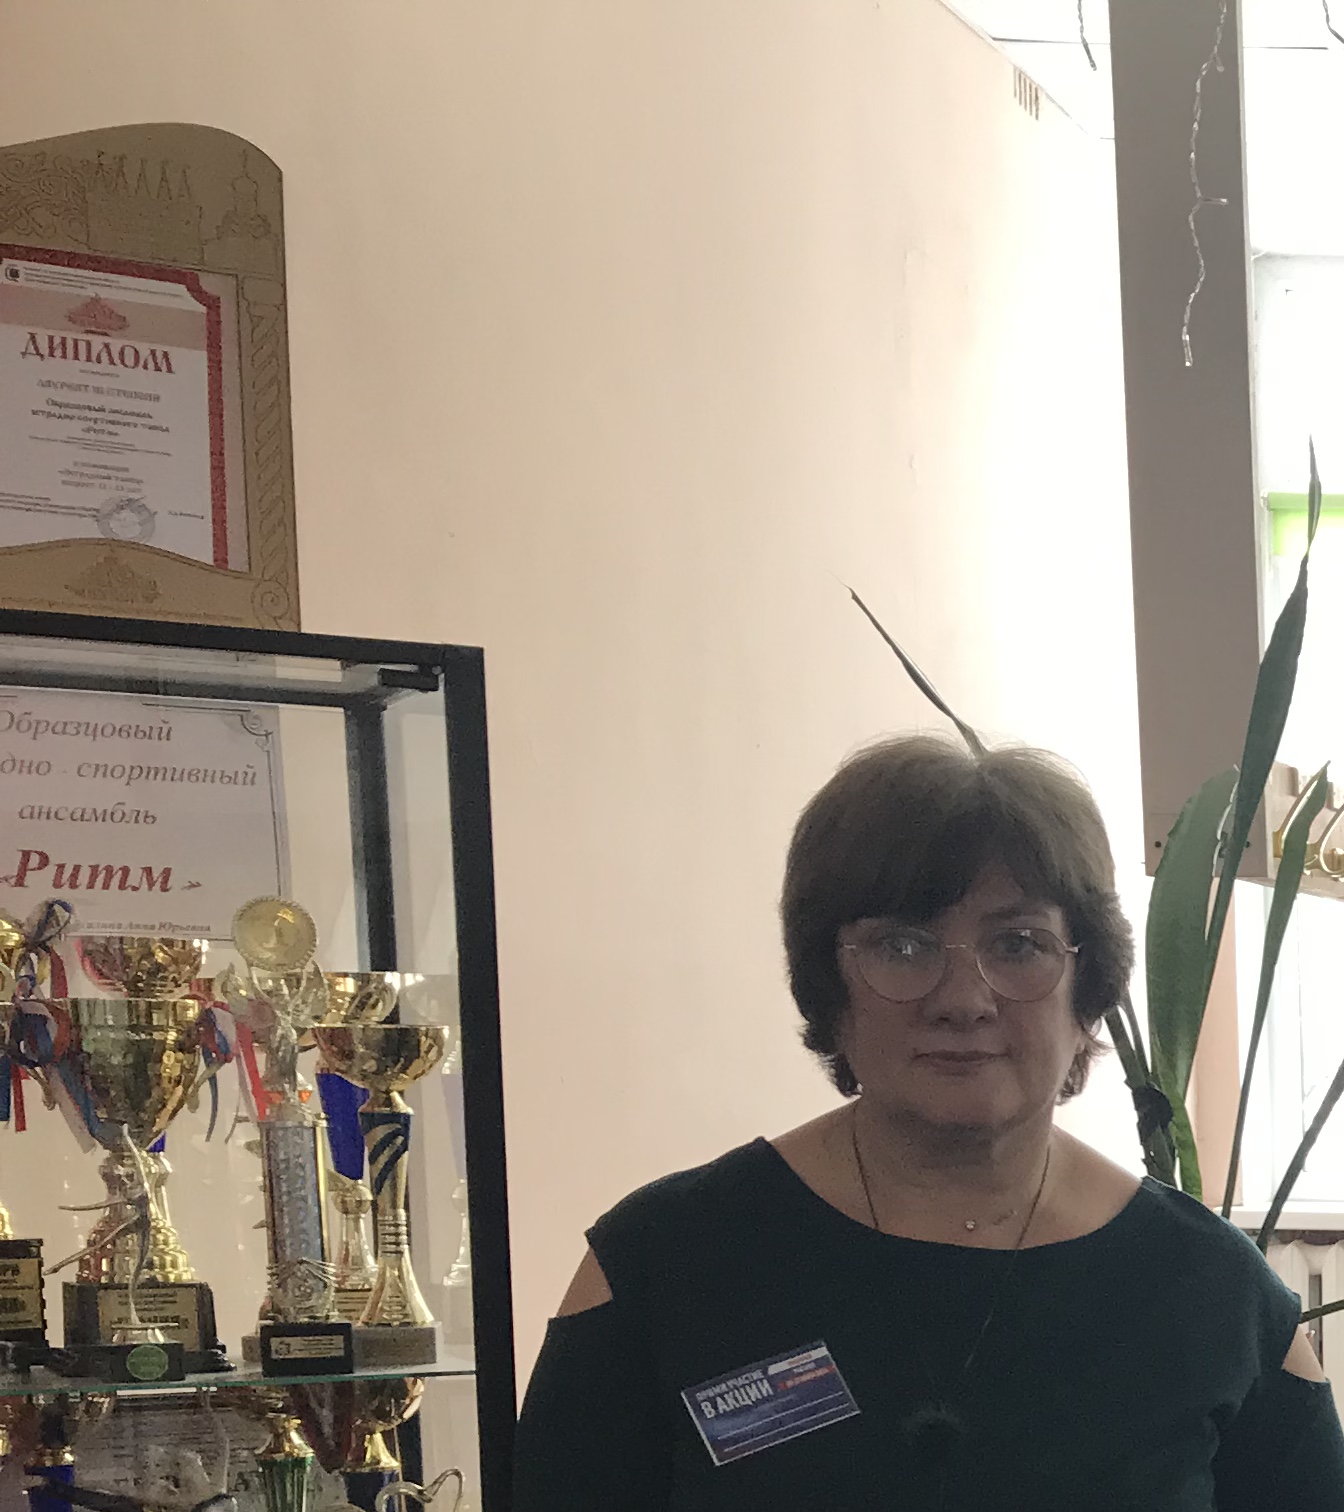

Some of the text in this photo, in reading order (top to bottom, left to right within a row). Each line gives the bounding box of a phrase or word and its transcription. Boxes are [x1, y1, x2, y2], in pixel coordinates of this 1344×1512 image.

[20, 331, 175, 375] ДИПЛОМ
[77, 761, 258, 786] спортивный
[18, 802, 158, 825] ансамбль
[701, 1379, 774, 1419] В АКЦИИ
